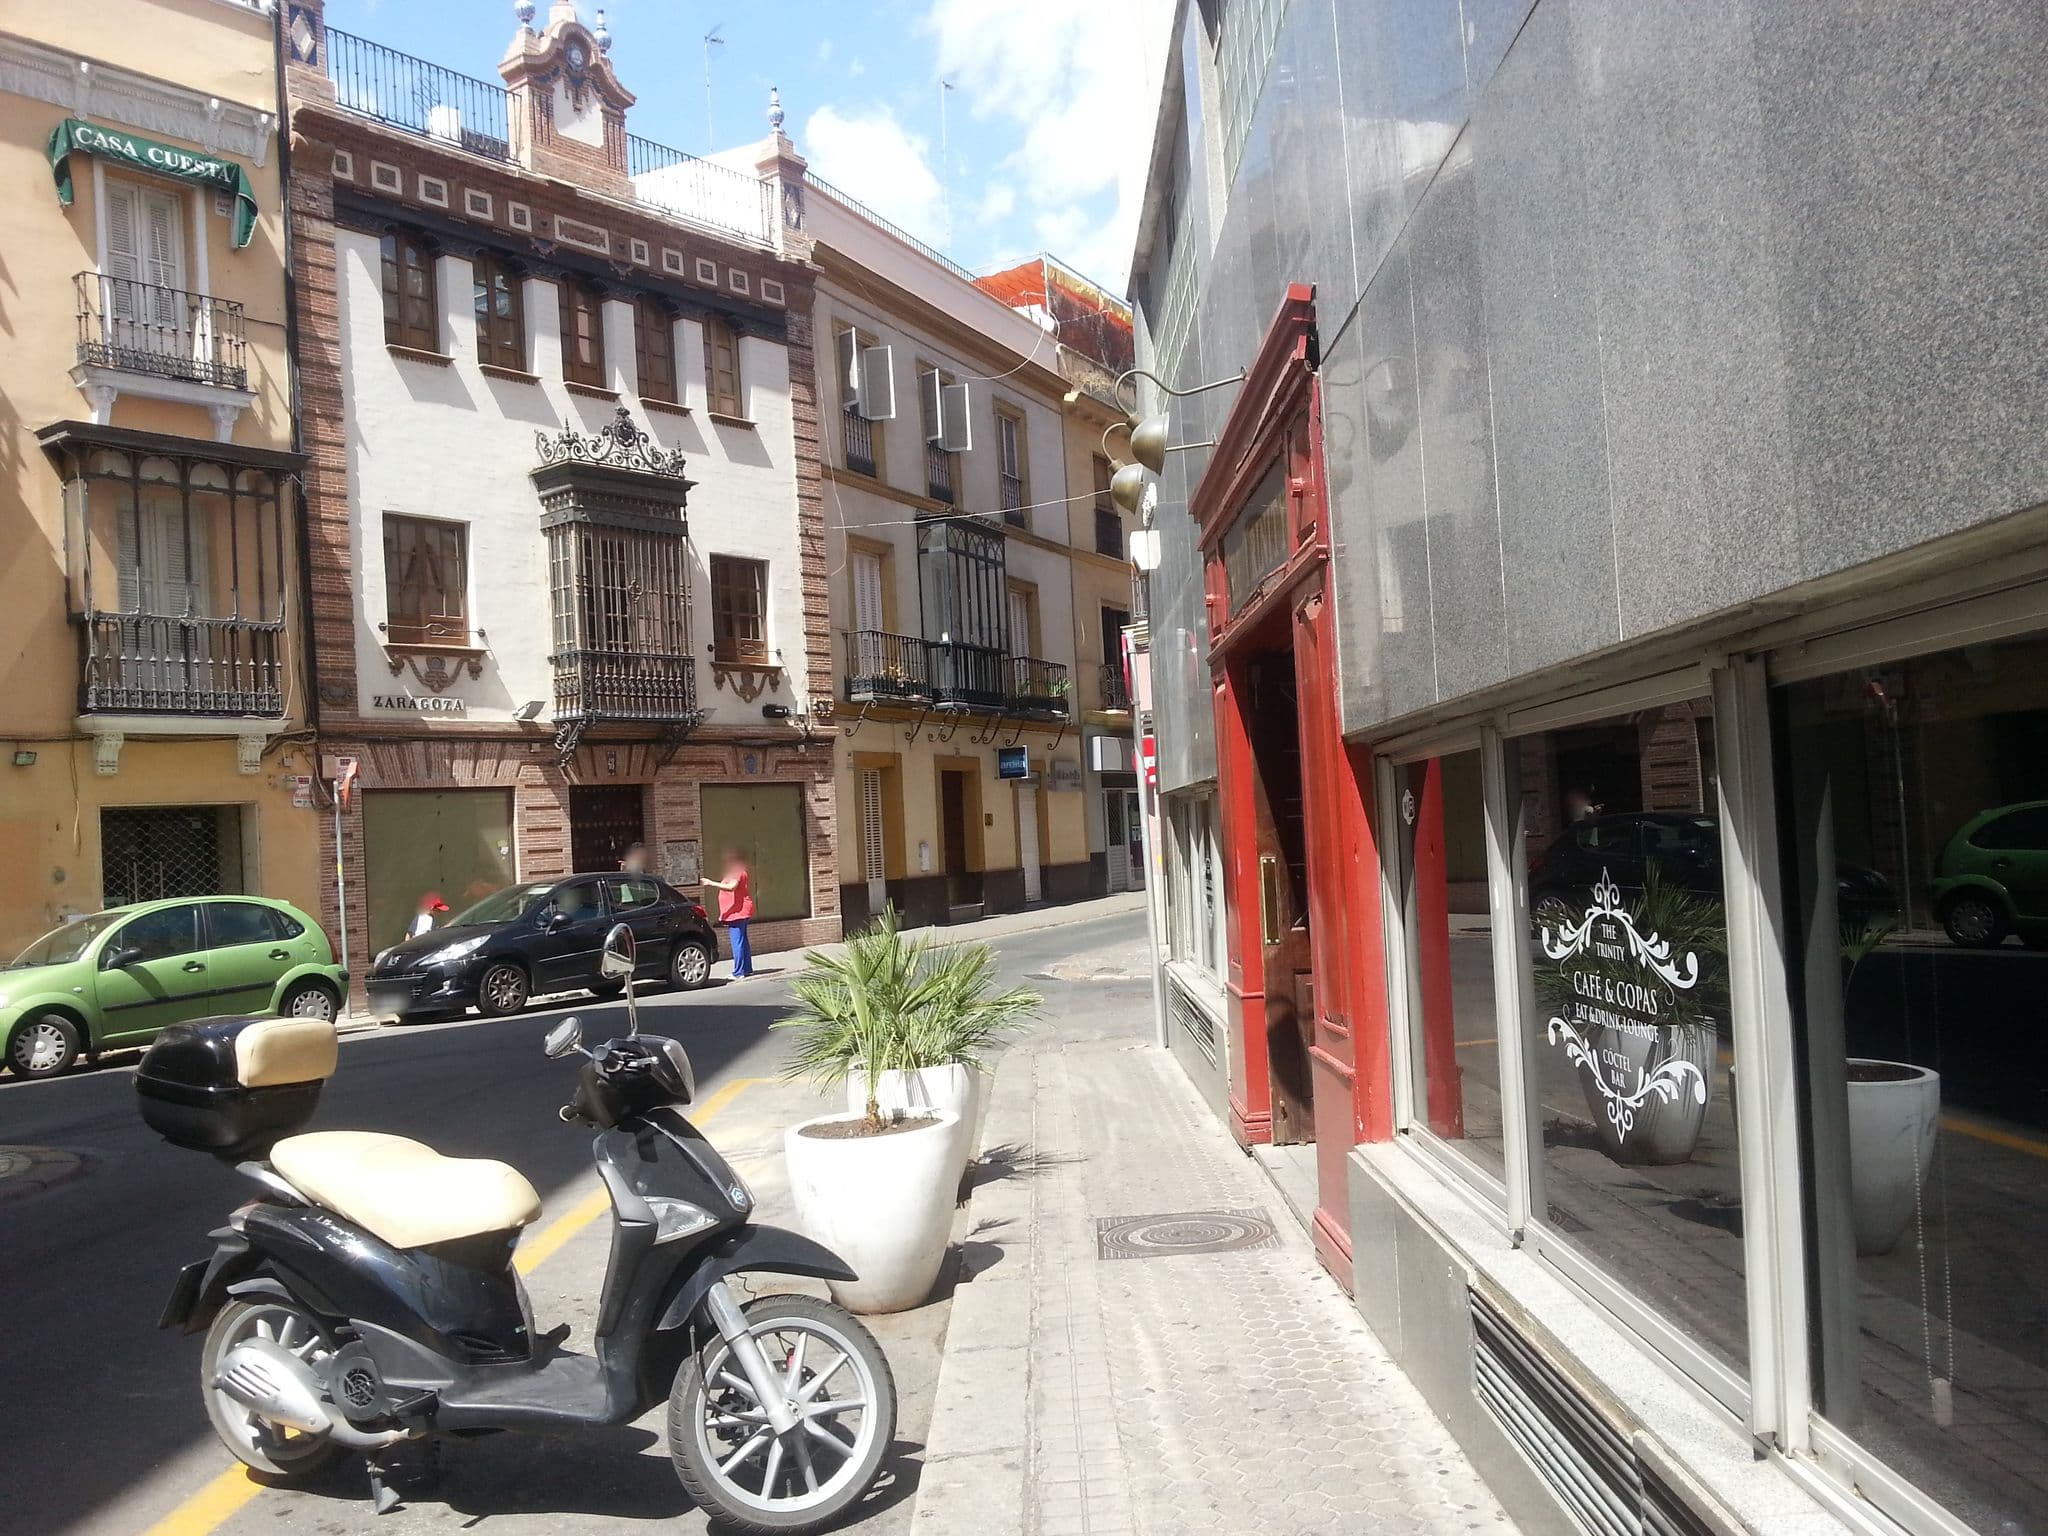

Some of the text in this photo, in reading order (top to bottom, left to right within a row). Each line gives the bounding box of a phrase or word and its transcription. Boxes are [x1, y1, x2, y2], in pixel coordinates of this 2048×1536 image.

[75, 127, 232, 184] CASA CUESTA
[373, 695, 464, 712] ZARAGOZA
[1601, 923, 1617, 940] THE
[1595, 942, 1625, 961] TRINITY
[1574, 970, 1658, 1015] CAFÉ & COPAS
[1575, 1002, 1588, 1020] EAT
[1603, 1048, 1632, 1073] CÓCTEL
[1610, 1069, 1626, 1089] BAR
